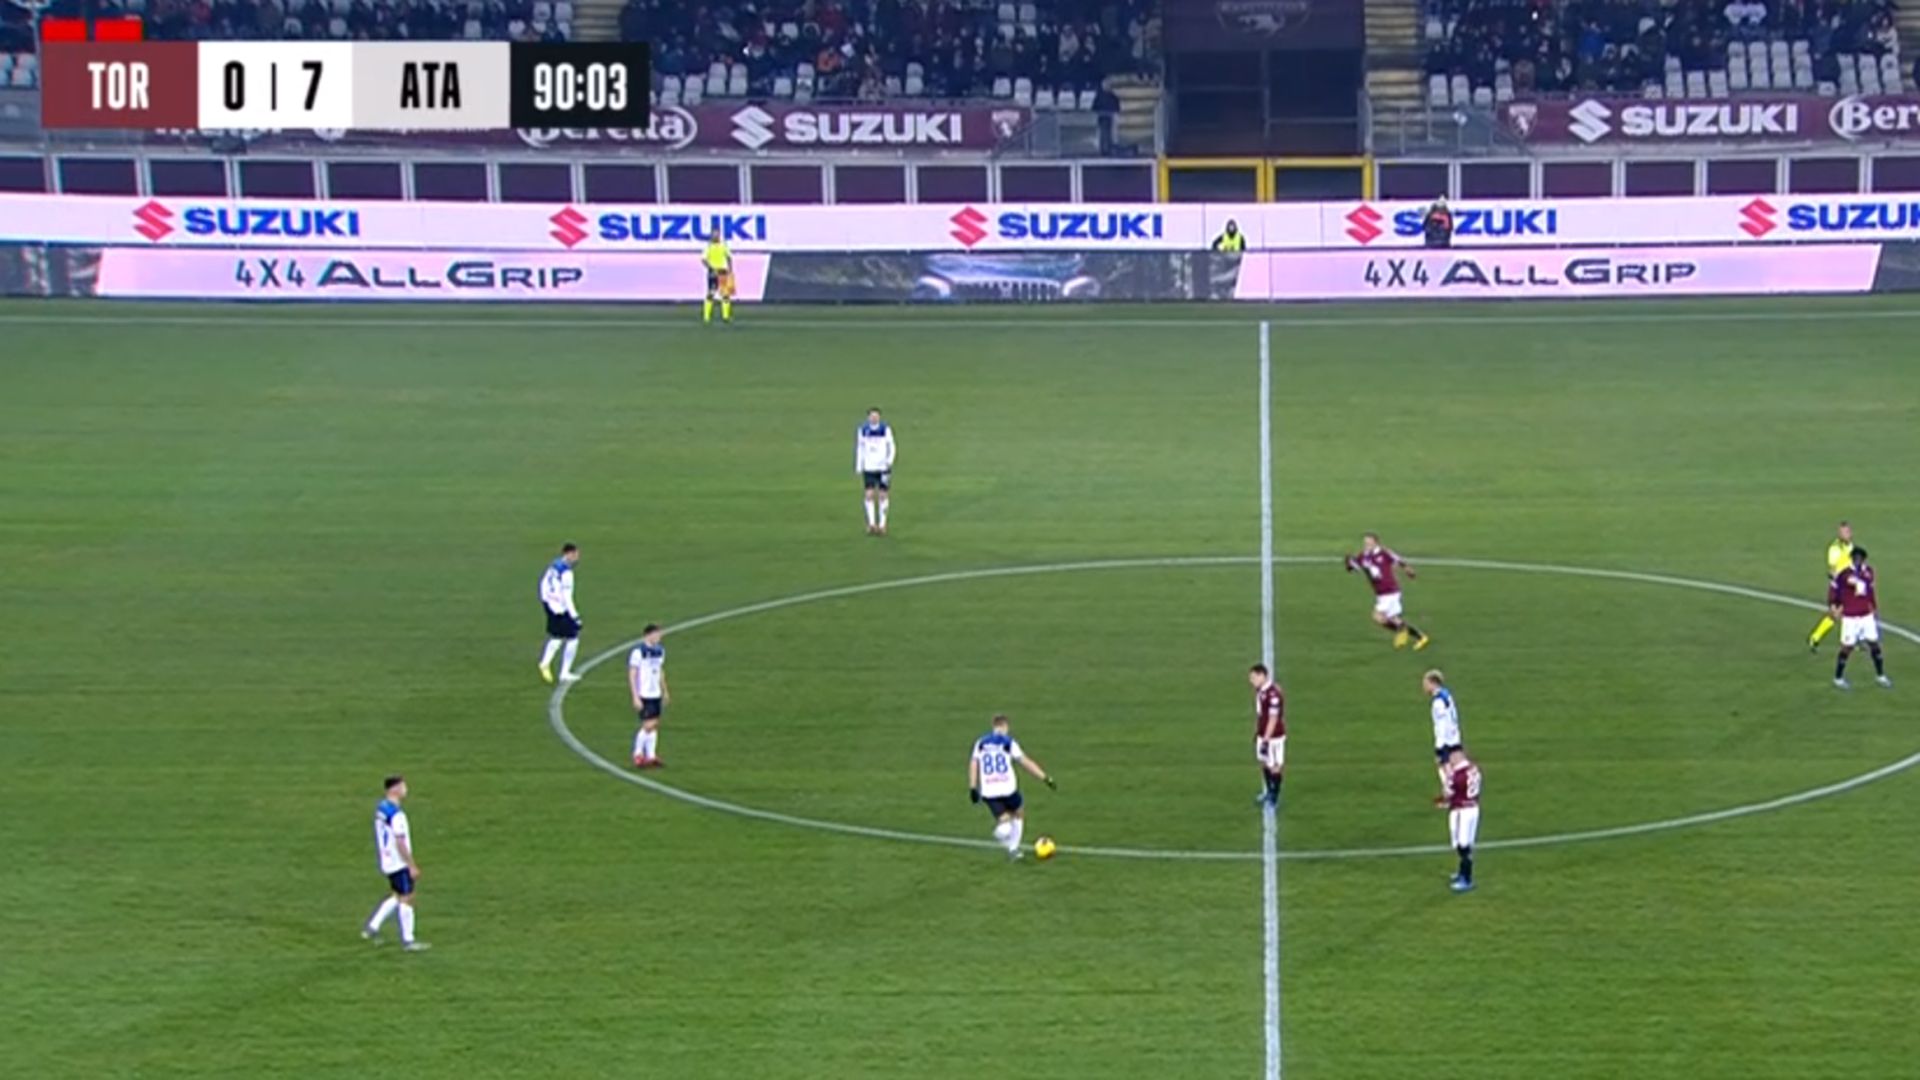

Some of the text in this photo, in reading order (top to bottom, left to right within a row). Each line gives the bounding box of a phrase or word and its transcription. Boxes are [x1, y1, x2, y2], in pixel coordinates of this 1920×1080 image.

[784, 111, 963, 143] SUZUKI
[1620, 103, 1798, 136] SUZUKI
[1841, 101, 1920, 132] Ber
[183, 206, 360, 237] SUZUKI
[598, 213, 767, 242] SUZUKI
[997, 211, 1163, 240] SUZUKI
[1393, 208, 1557, 237] SZUKI
[982, 752, 1008, 776] 88
